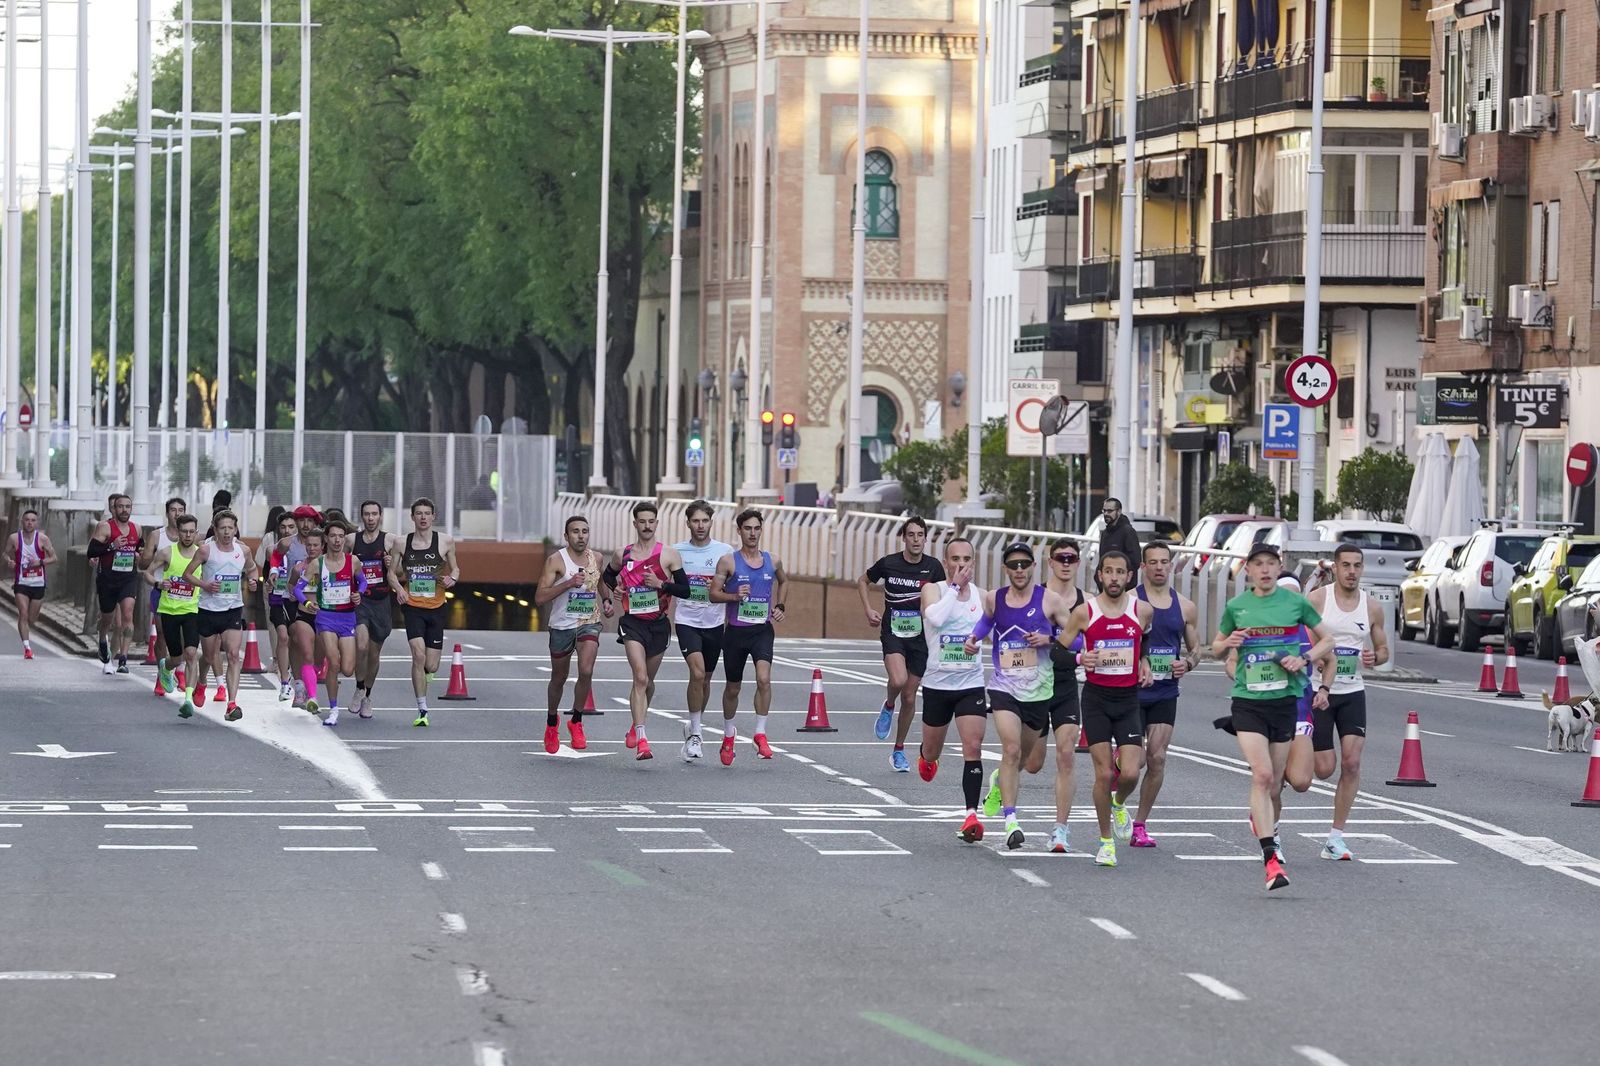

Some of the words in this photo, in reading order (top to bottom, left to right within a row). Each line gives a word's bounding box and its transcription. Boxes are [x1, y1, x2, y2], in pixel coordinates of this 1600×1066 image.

[1385, 368, 1416, 377] LUIS
[1500, 388, 1557, 402] TINTE
[1268, 409, 1290, 438] P
[888, 576, 921, 587] RUNNING
[632, 599, 656, 608] MORENO
[943, 653, 973, 661] ARNAUD
[1012, 659, 1024, 667] AKI
[1102, 659, 1127, 667] SIMON
[1260, 673, 1274, 681] NIC
